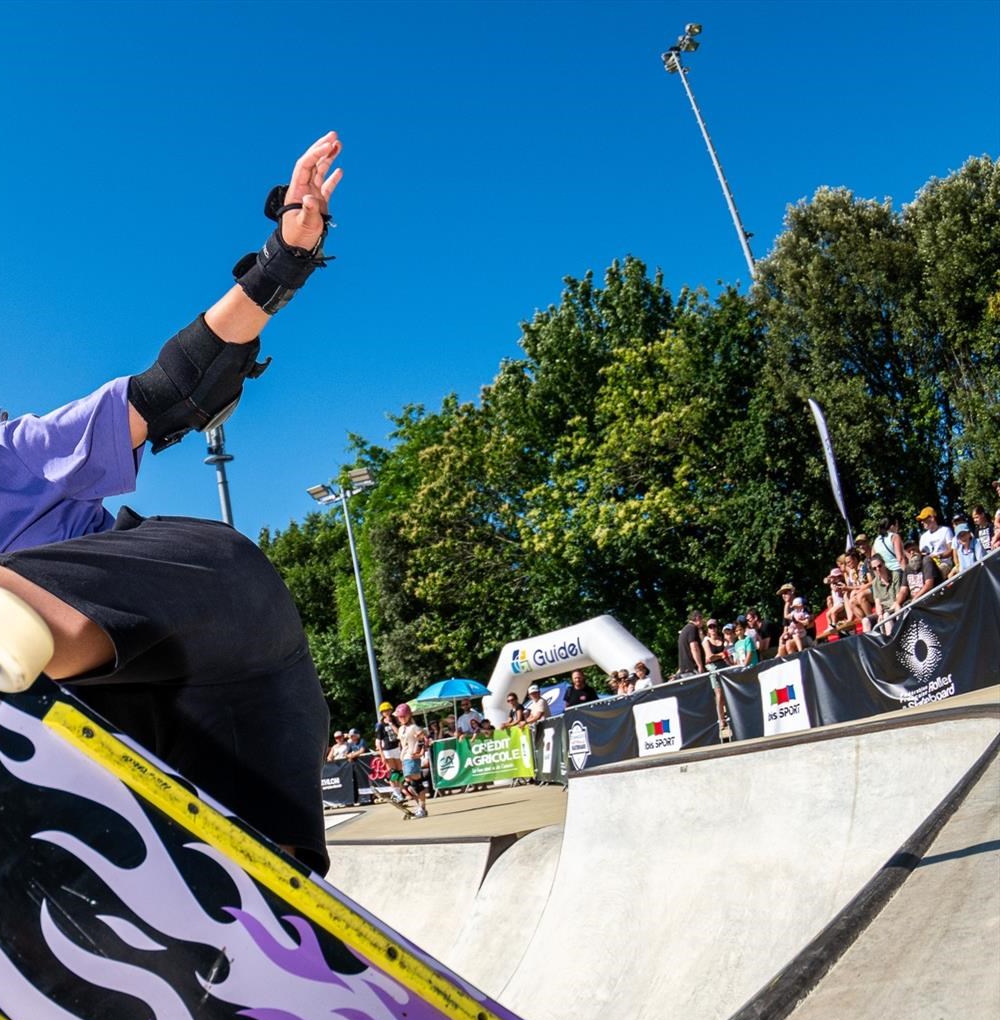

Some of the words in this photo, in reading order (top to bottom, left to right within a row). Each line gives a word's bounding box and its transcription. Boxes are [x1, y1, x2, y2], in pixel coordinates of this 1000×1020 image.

[533, 636, 584, 666] Guidel
[928, 673, 953, 693] Roller
[779, 703, 801, 719] SPORT
[471, 738, 510, 755] CRÉDIT
[655, 736, 676, 748] SPORT
[464, 748, 520, 768] AGRICOLE
